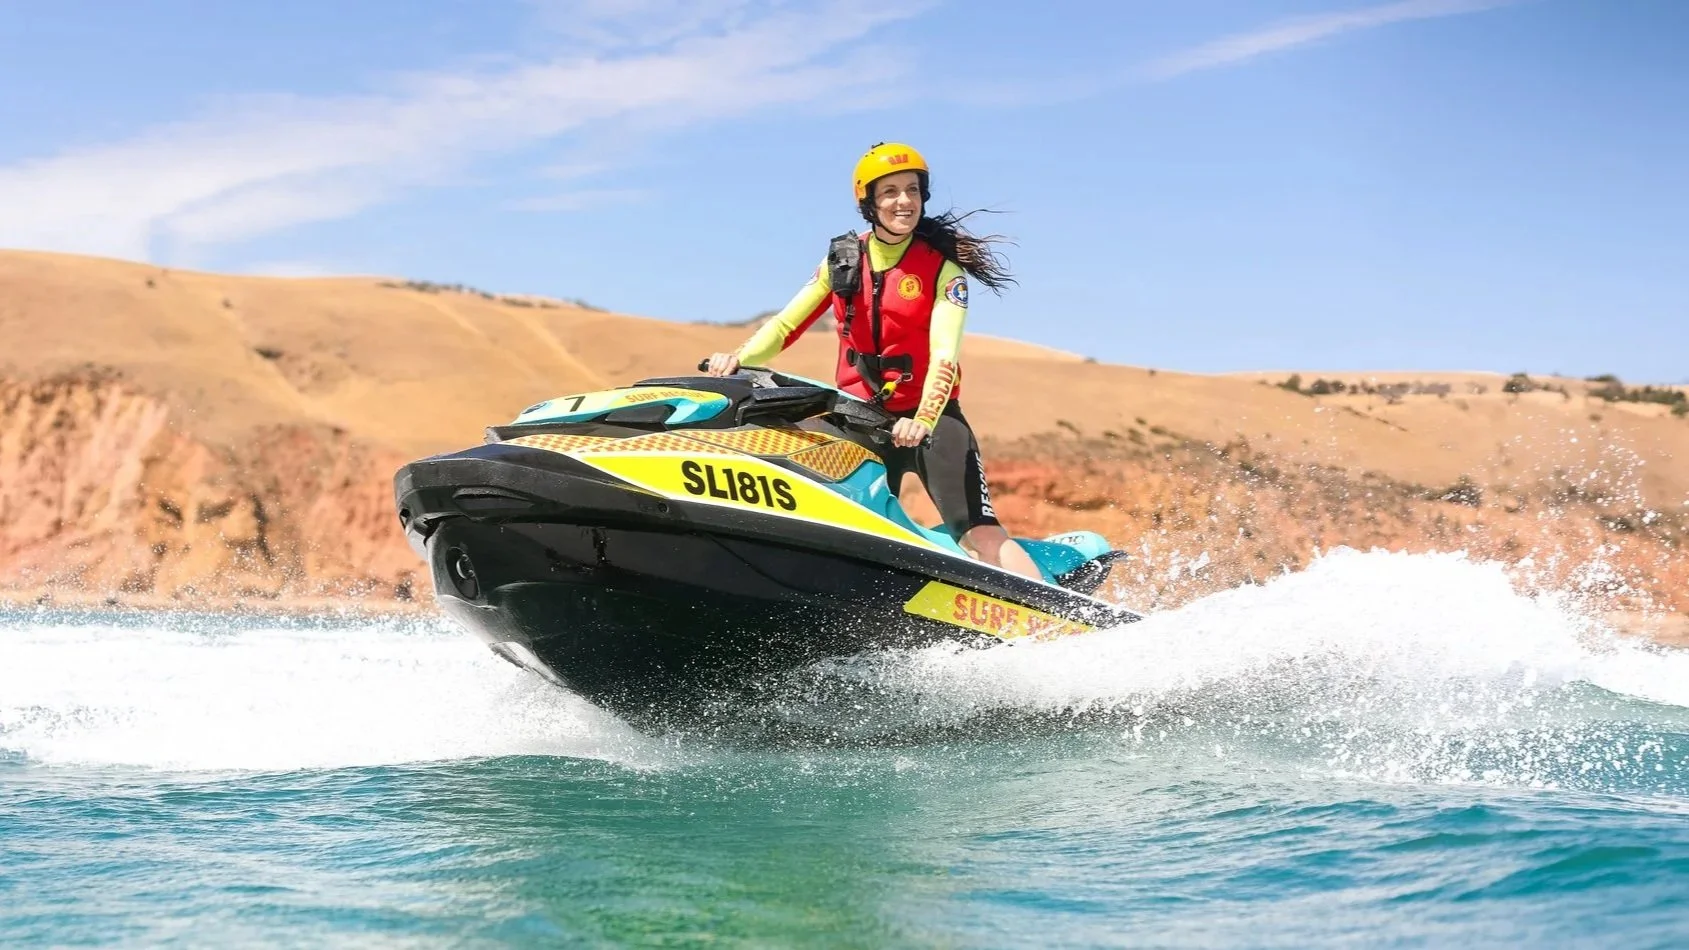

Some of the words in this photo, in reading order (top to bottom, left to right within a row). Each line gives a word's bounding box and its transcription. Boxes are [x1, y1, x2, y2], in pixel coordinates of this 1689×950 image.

[564, 395, 587, 413] 7
[624, 391, 659, 403] SURF
[916, 359, 956, 422] RESCUE
[681, 460, 797, 511] SL181S
[953, 593, 1020, 634] SURF
